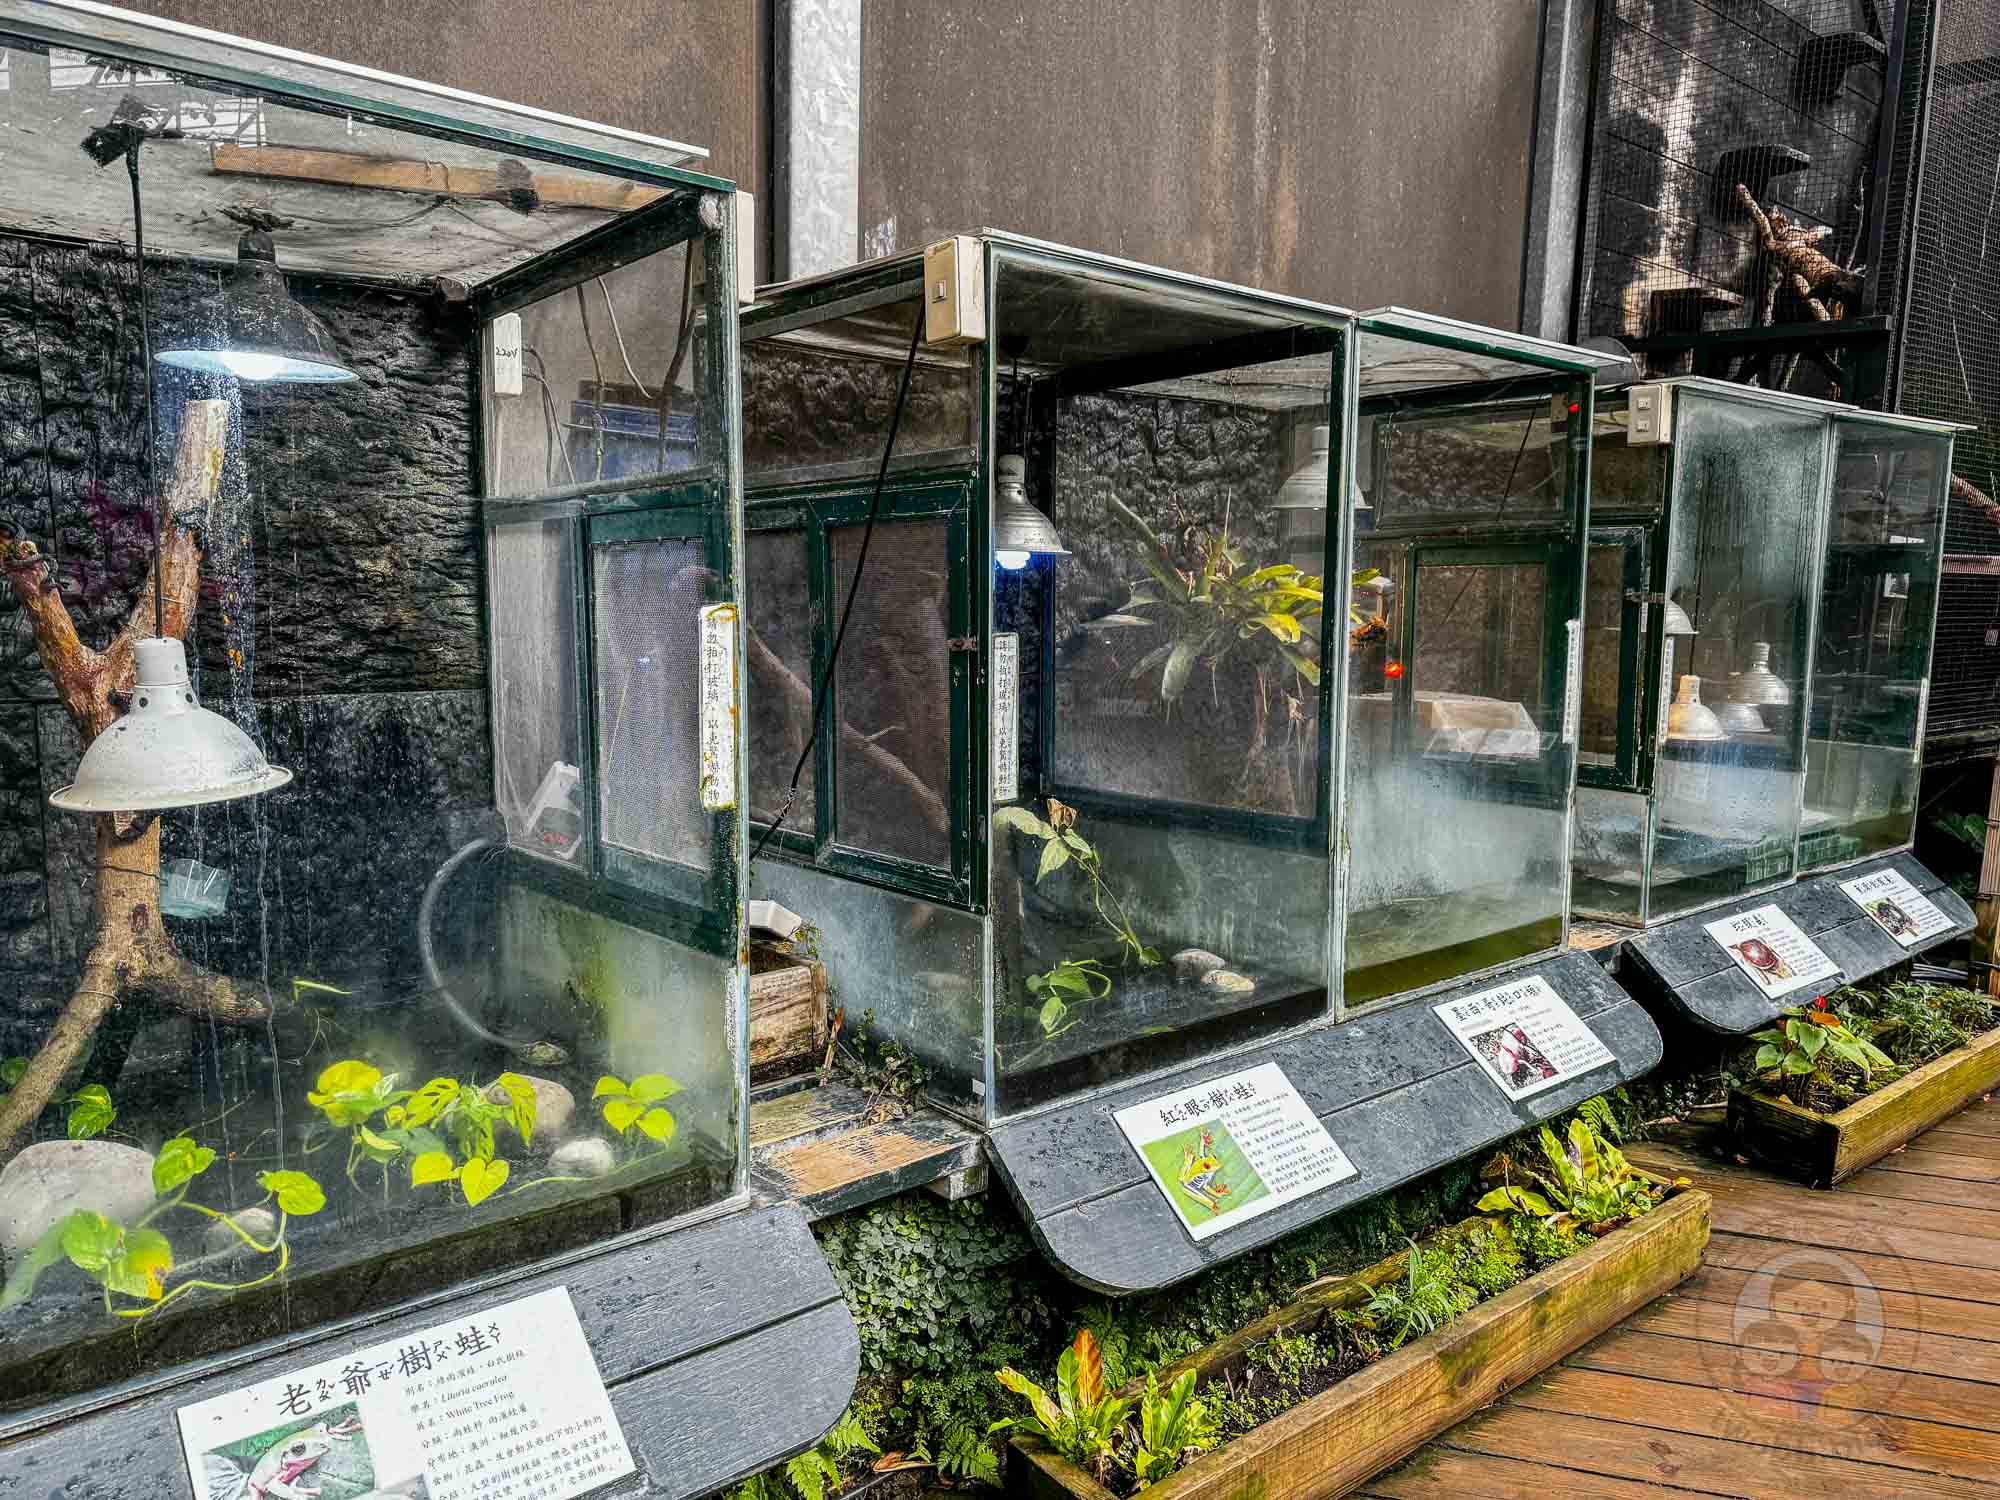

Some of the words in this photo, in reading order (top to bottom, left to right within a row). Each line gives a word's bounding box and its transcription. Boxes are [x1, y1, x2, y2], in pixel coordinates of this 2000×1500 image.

[495, 346, 518, 359] 220V
[1160, 1082, 1256, 1127] 紅眼樹蛙
[277, 1324, 500, 1416] 老爺樹蛙
[446, 1406, 474, 1420] White
[473, 1399, 494, 1410] Tree
[494, 1391, 515, 1405] Frog
